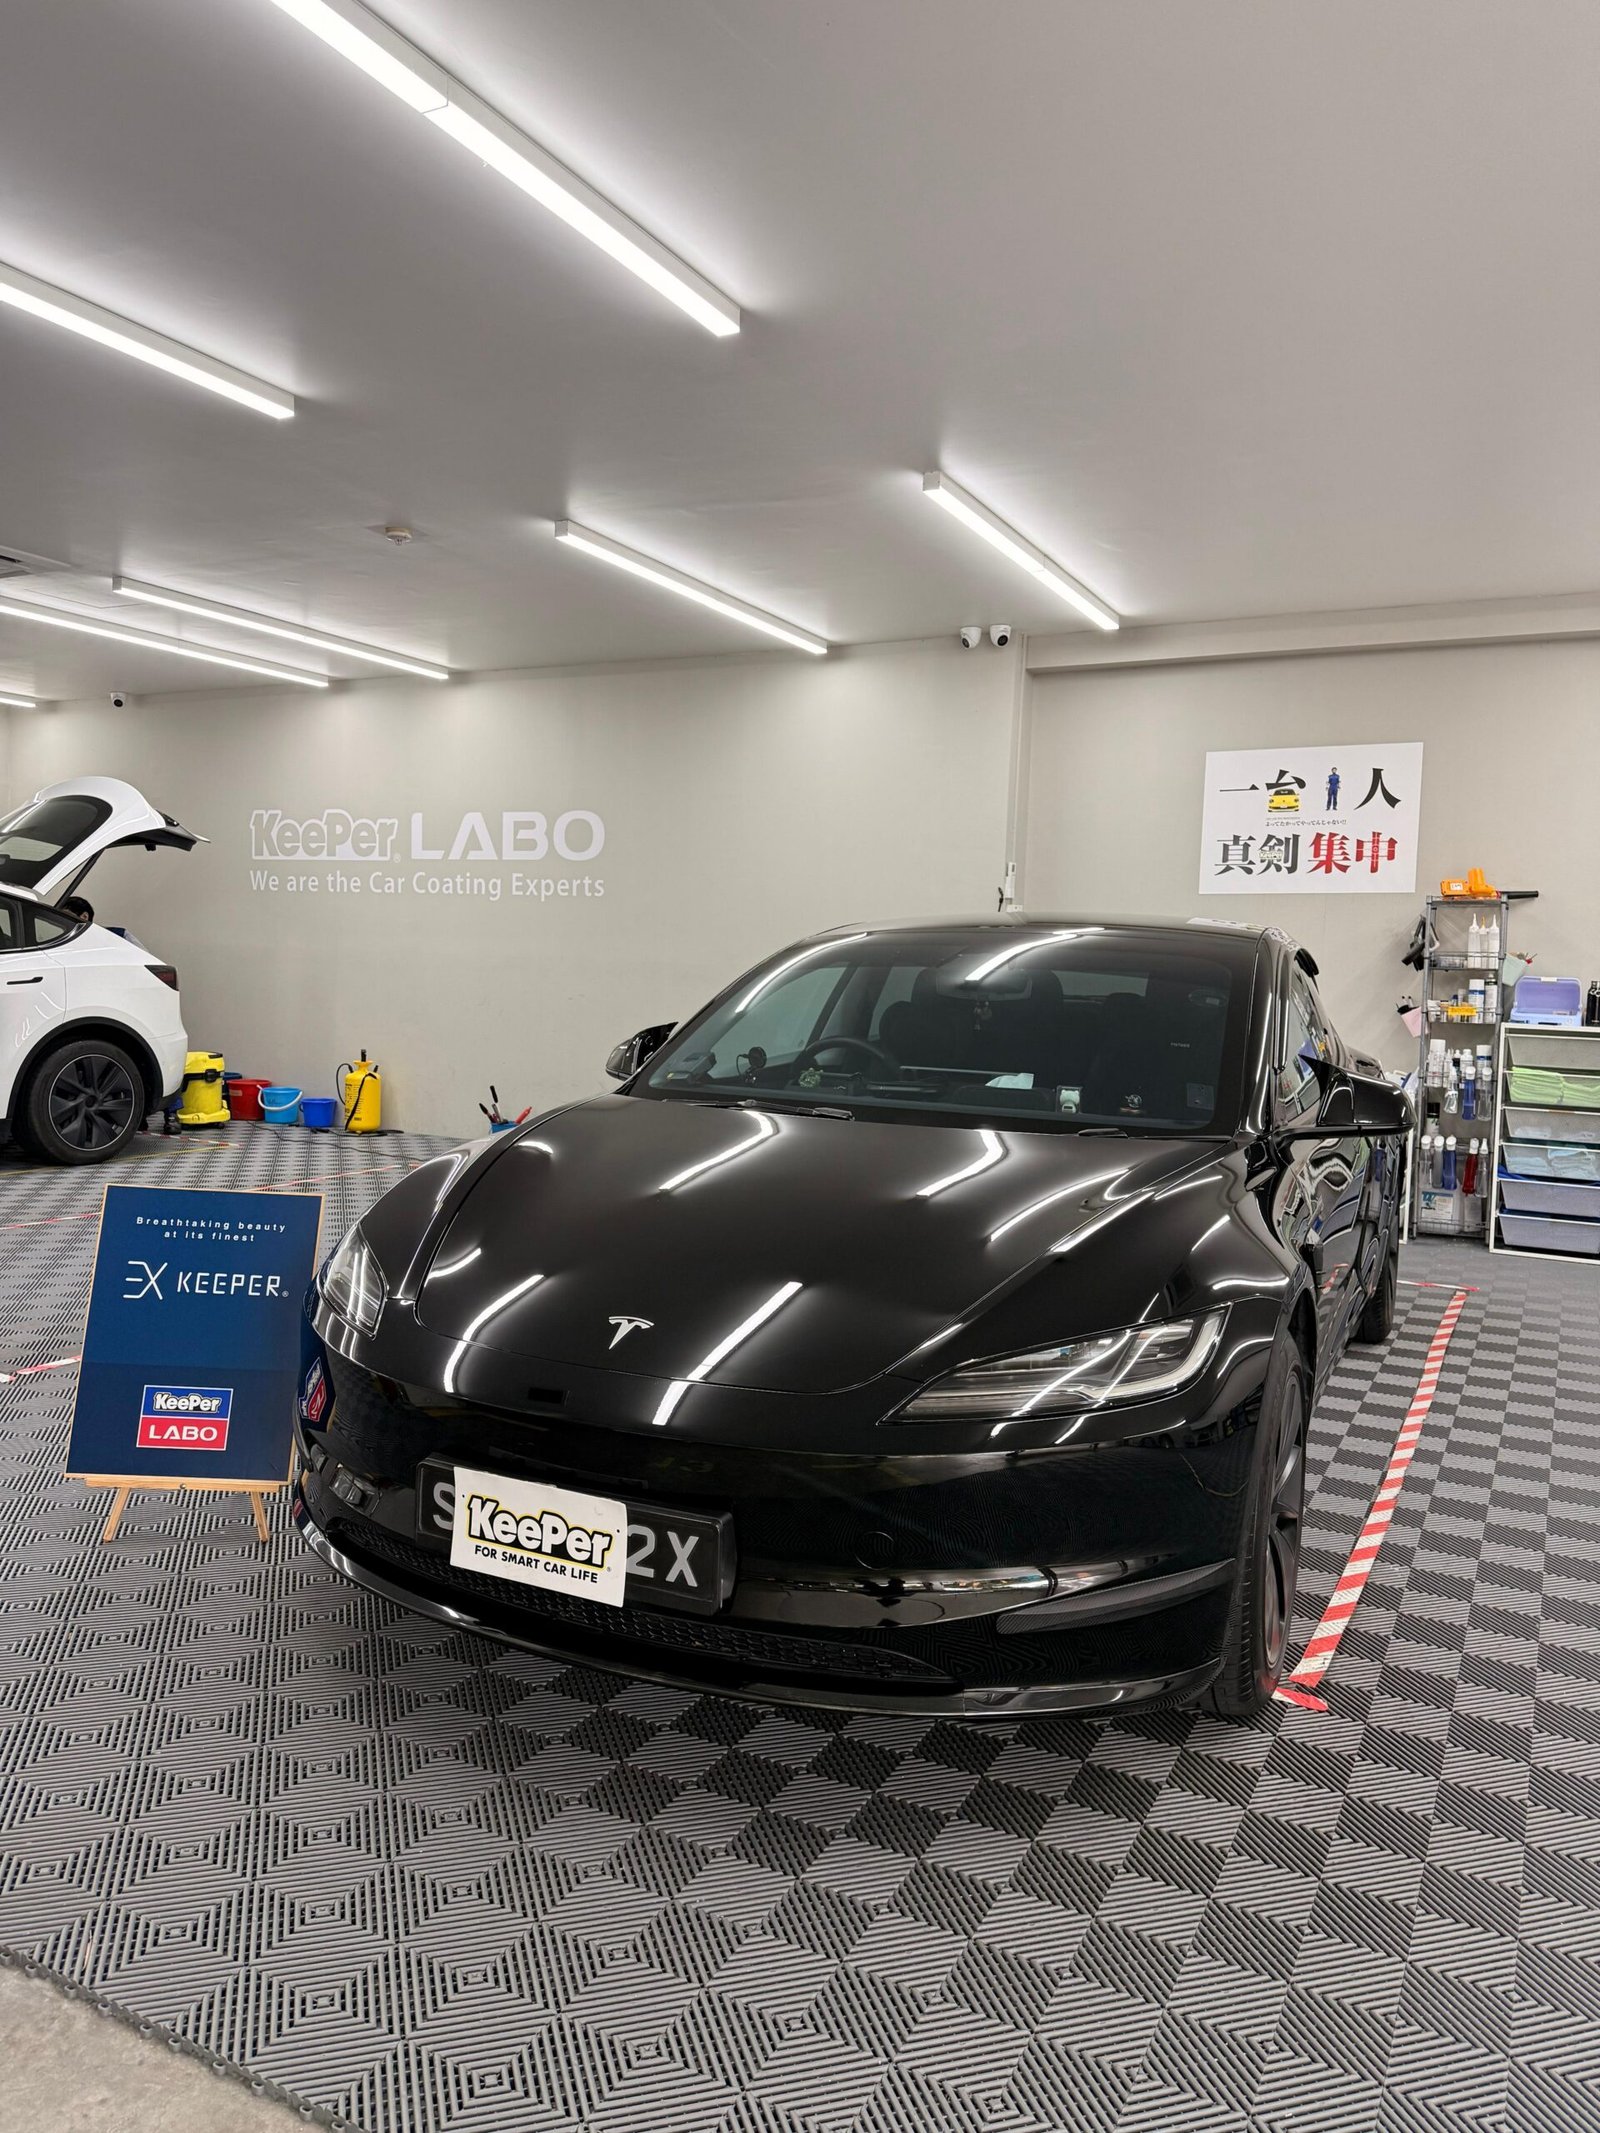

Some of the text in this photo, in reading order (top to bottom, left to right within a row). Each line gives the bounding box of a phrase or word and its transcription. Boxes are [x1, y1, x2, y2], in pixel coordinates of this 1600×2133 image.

[250, 808, 606, 861] KeePer LABO
[249, 870, 605, 901] We are the Car Coating Experts
[136, 1216, 287, 1233] Breathtaking beauty
[164, 1231, 256, 1242] at its finest
[177, 1271, 281, 1297] KEEPER
[153, 1392, 222, 1413] KeePer
[149, 1424, 218, 1442] LABO
[467, 1494, 613, 1568] KeePer
[474, 1545, 598, 1584] FOR SMART CAR LIFE
